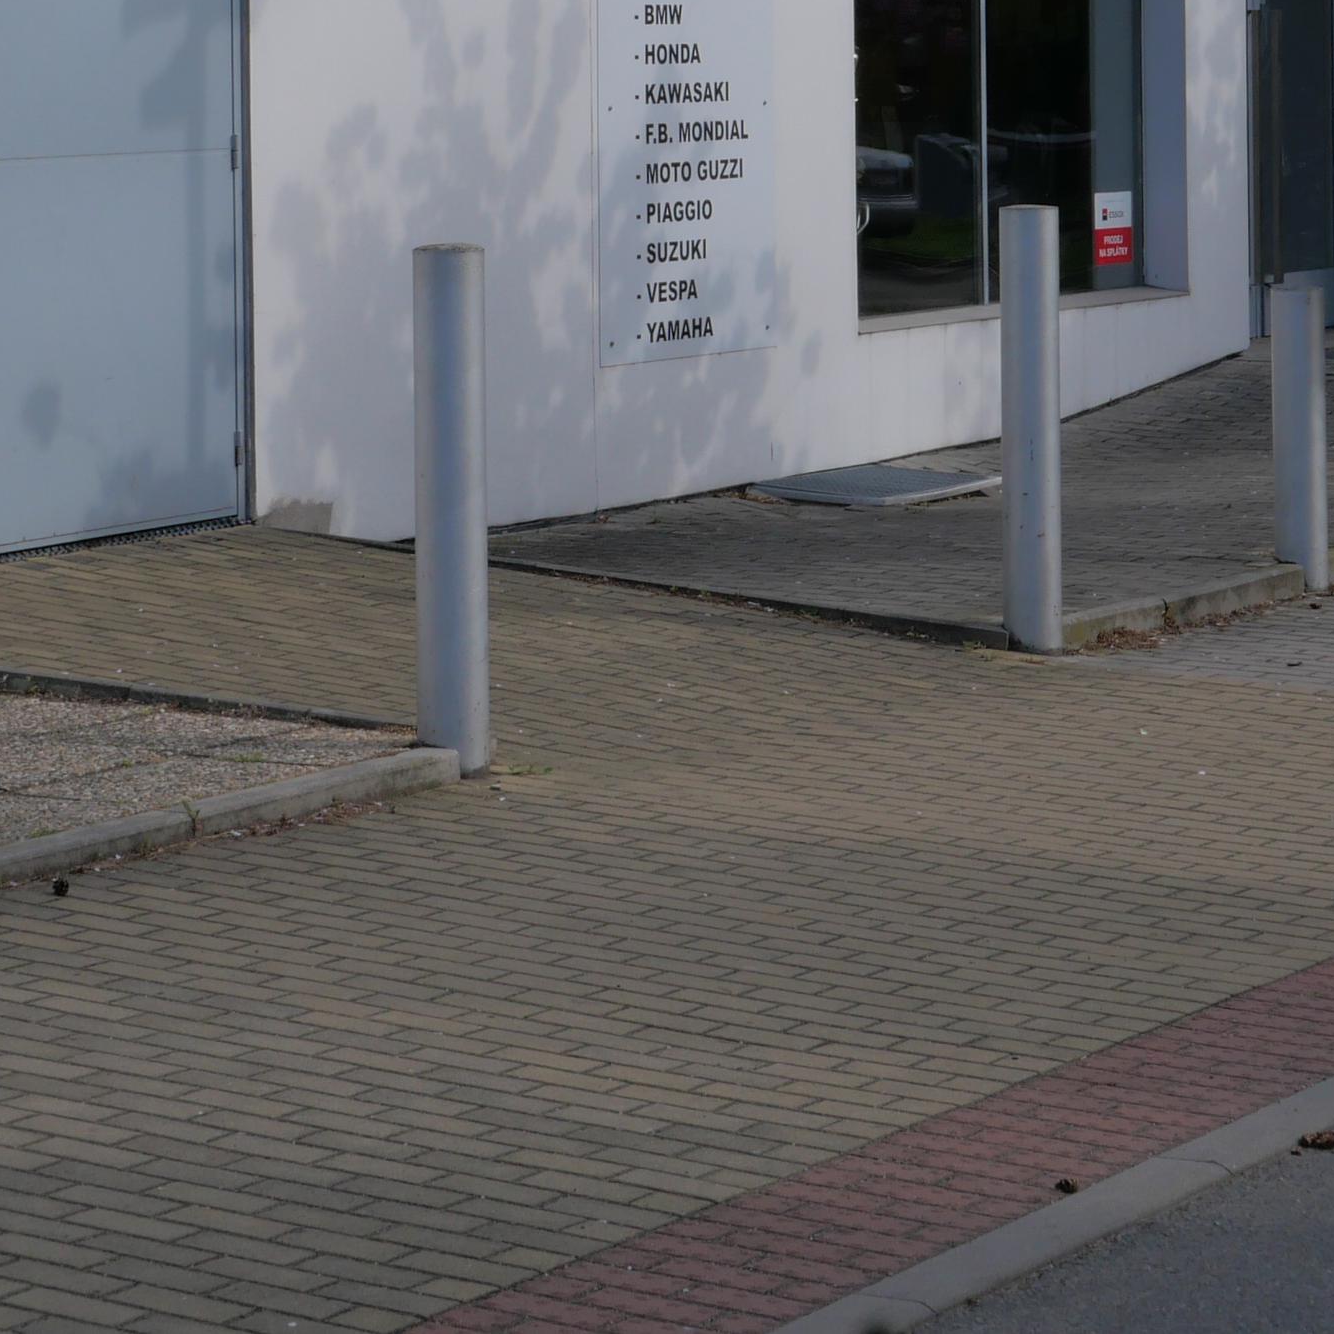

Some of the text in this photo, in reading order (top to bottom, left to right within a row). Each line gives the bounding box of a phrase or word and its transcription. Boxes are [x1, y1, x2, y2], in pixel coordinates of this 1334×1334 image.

[644, 4, 682, 25] BMW
[644, 43, 701, 65] HONDA
[645, 81, 730, 105] KAWASAKI
[646, 119, 748, 144] F.B. MONDIAL
[646, 158, 743, 184] MOTO GUZZI
[646, 199, 713, 224] PIAGGIO
[646, 239, 707, 264] SUZUKI
[646, 279, 698, 303] VESPA
[647, 316, 713, 343] YAMAHA
